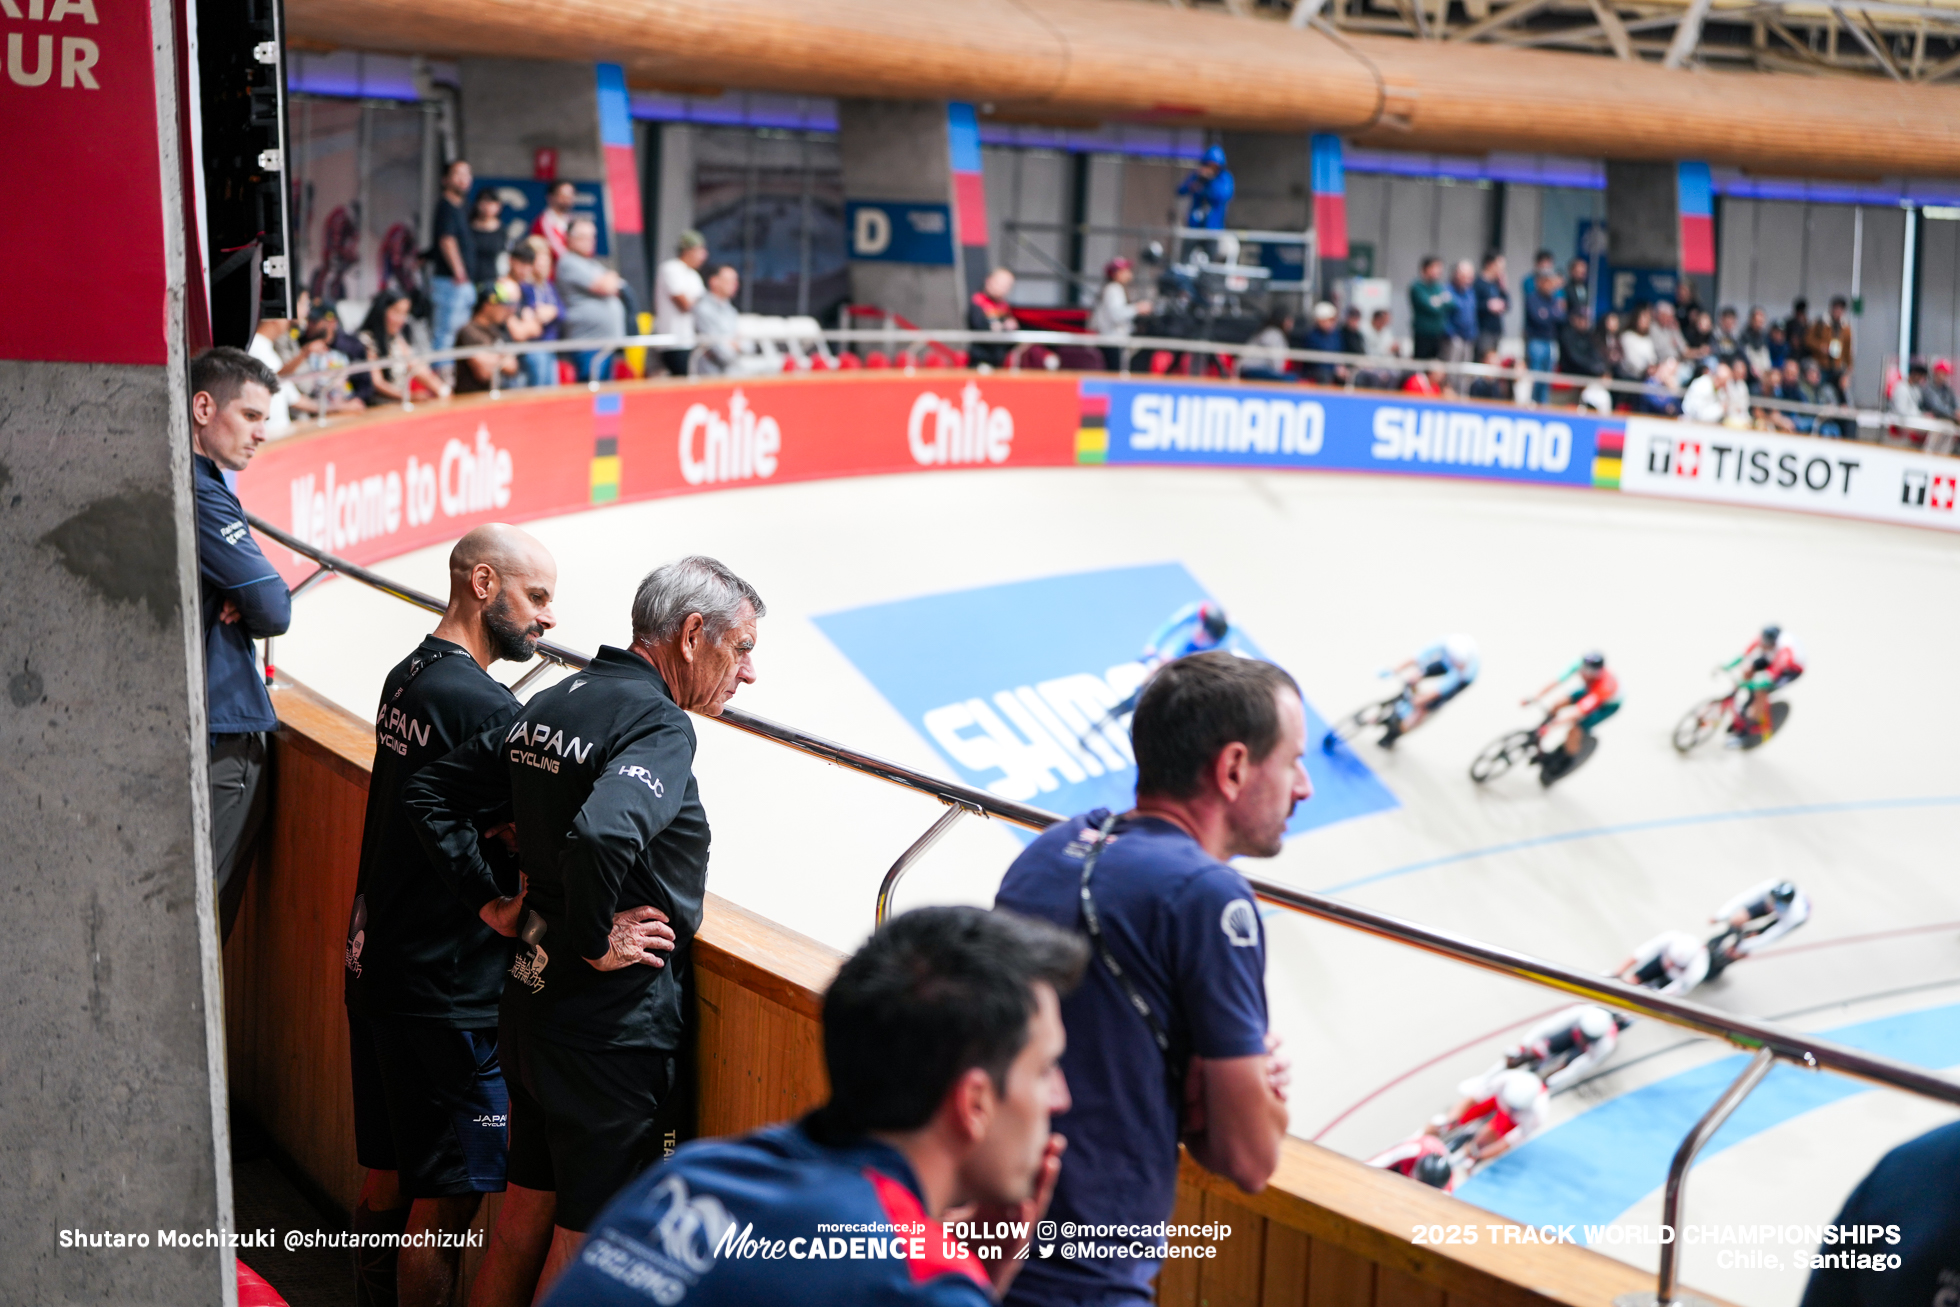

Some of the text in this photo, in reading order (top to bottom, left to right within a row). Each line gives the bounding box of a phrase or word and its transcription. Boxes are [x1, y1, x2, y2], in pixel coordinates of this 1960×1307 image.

[0, 32, 100, 90] UR
[854, 206, 892, 255] D
[678, 386, 781, 486] Chile
[907, 380, 1014, 466] Chile
[1129, 393, 1325, 455] SHIMANO
[1371, 405, 1573, 473] SHIMANO
[291, 420, 514, 566] Welcome to Chile
[1712, 444, 1860, 494] TISSOT
[376, 703, 431, 747] APAN
[378, 731, 408, 757] YCLING
[505, 720, 594, 765] JAPAN
[510, 748, 561, 775] CYCLING
[472, 1114, 507, 1122] JAPA
